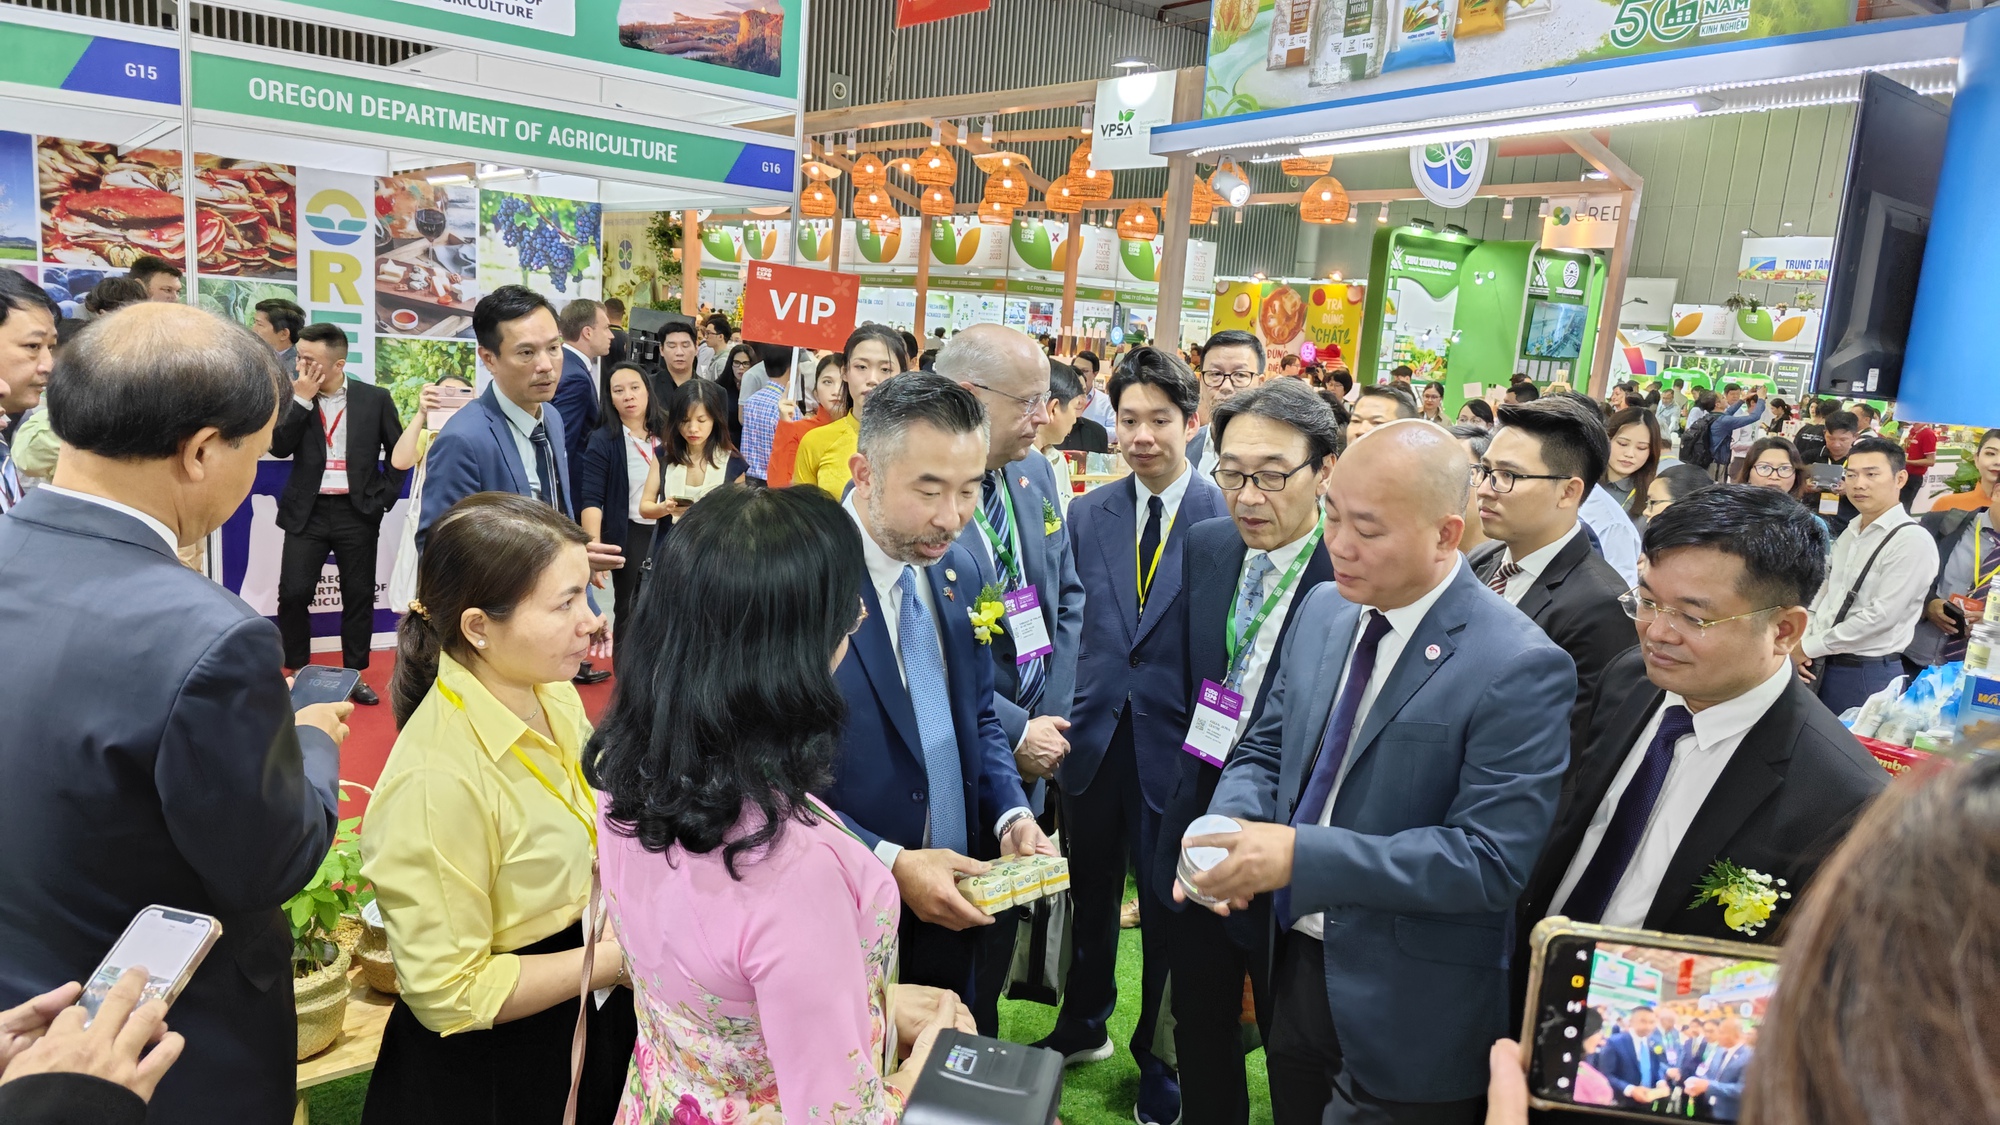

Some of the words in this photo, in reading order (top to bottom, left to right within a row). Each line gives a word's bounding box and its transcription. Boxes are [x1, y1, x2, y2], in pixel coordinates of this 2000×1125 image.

[437, 0, 534, 20] RICULTURE
[1700, 24, 1718, 35] KINH
[1720, 18, 1748, 32] NGHIỆM
[124, 62, 158, 81] G15
[248, 76, 354, 115] OREGON
[360, 96, 510, 138] DEPARTMENT
[515, 119, 542, 142] OF
[547, 126, 678, 164] AGRICULTURE
[1101, 123, 1133, 137] VPSA
[761, 160, 781, 174] G16
[1785, 259, 1812, 270] TRUNG
[769, 288, 836, 325] VIP
[1326, 298, 1343, 310] TRÀ
[1322, 310, 1344, 324] ĐÚNG
[1316, 325, 1344, 343] CHẤT
[1874, 756, 1912, 774] mbo
